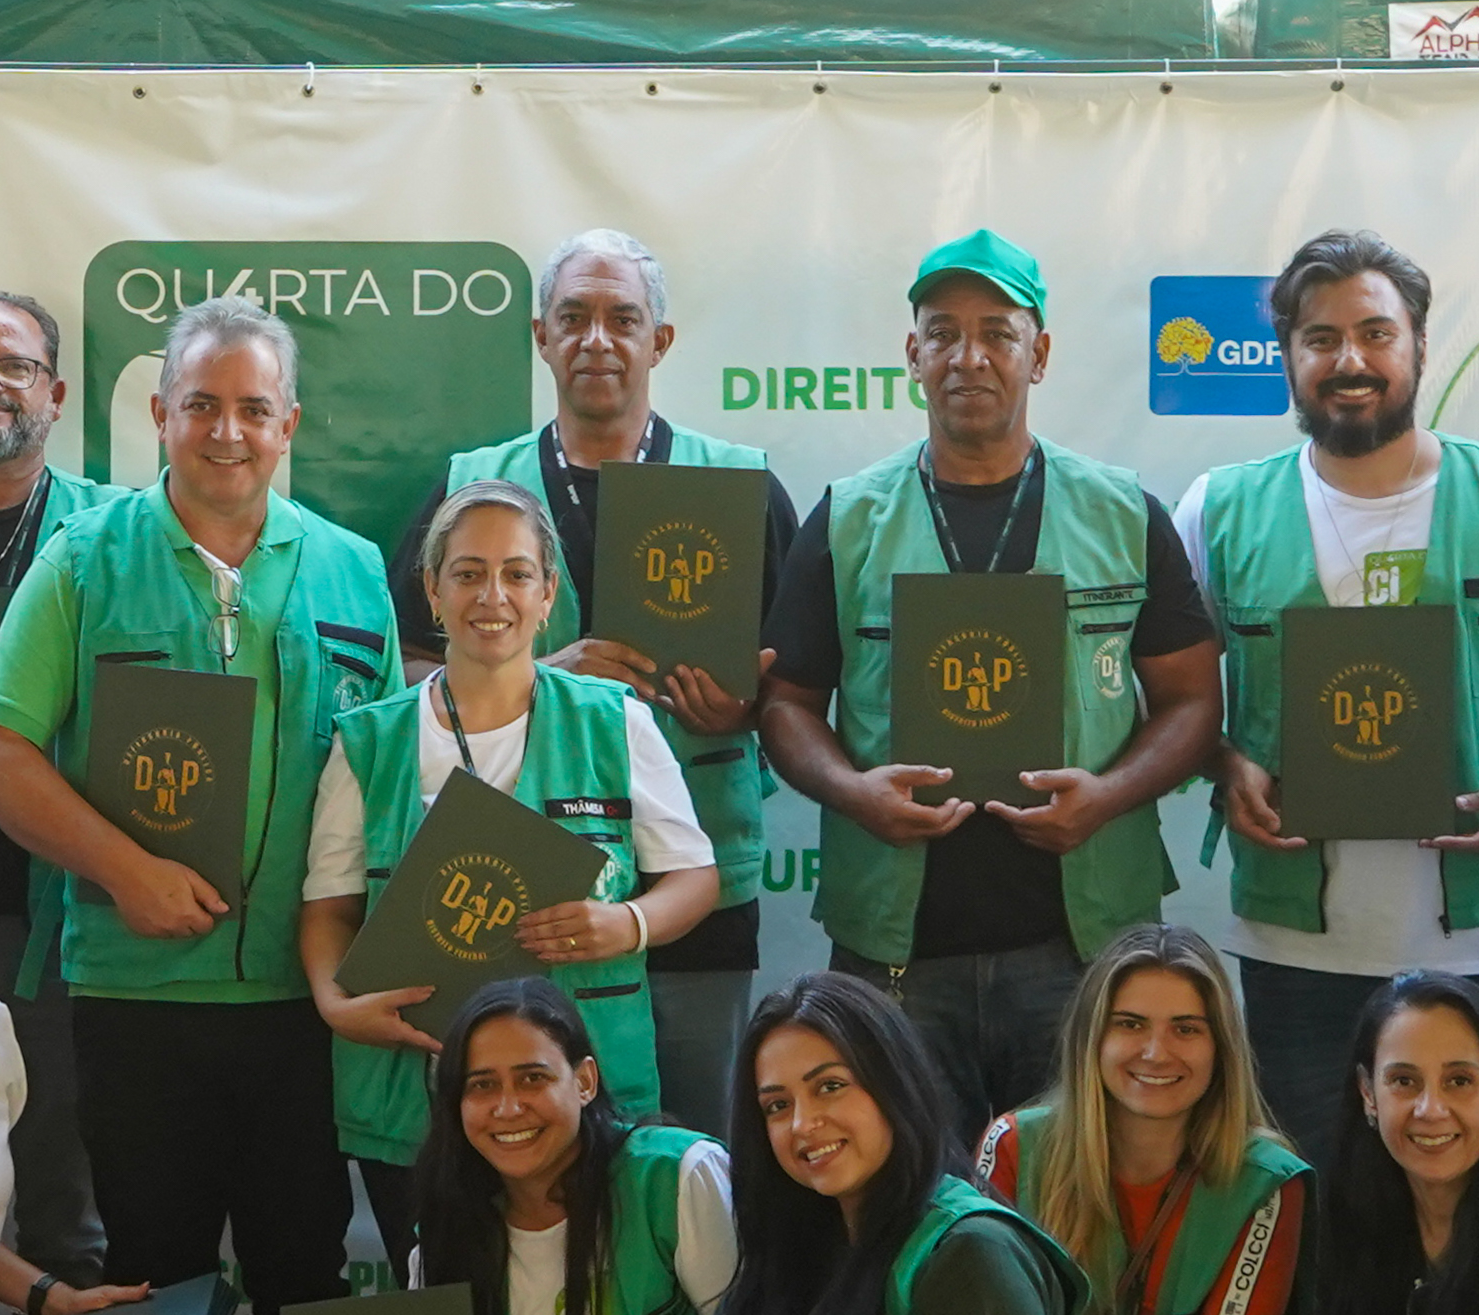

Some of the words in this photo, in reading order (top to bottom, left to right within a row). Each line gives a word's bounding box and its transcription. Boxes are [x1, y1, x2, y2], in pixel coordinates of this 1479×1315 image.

[412, 267, 514, 318] DO
[1367, 566, 1400, 605] CI
[1235, 1223, 1269, 1292] COLCCI
